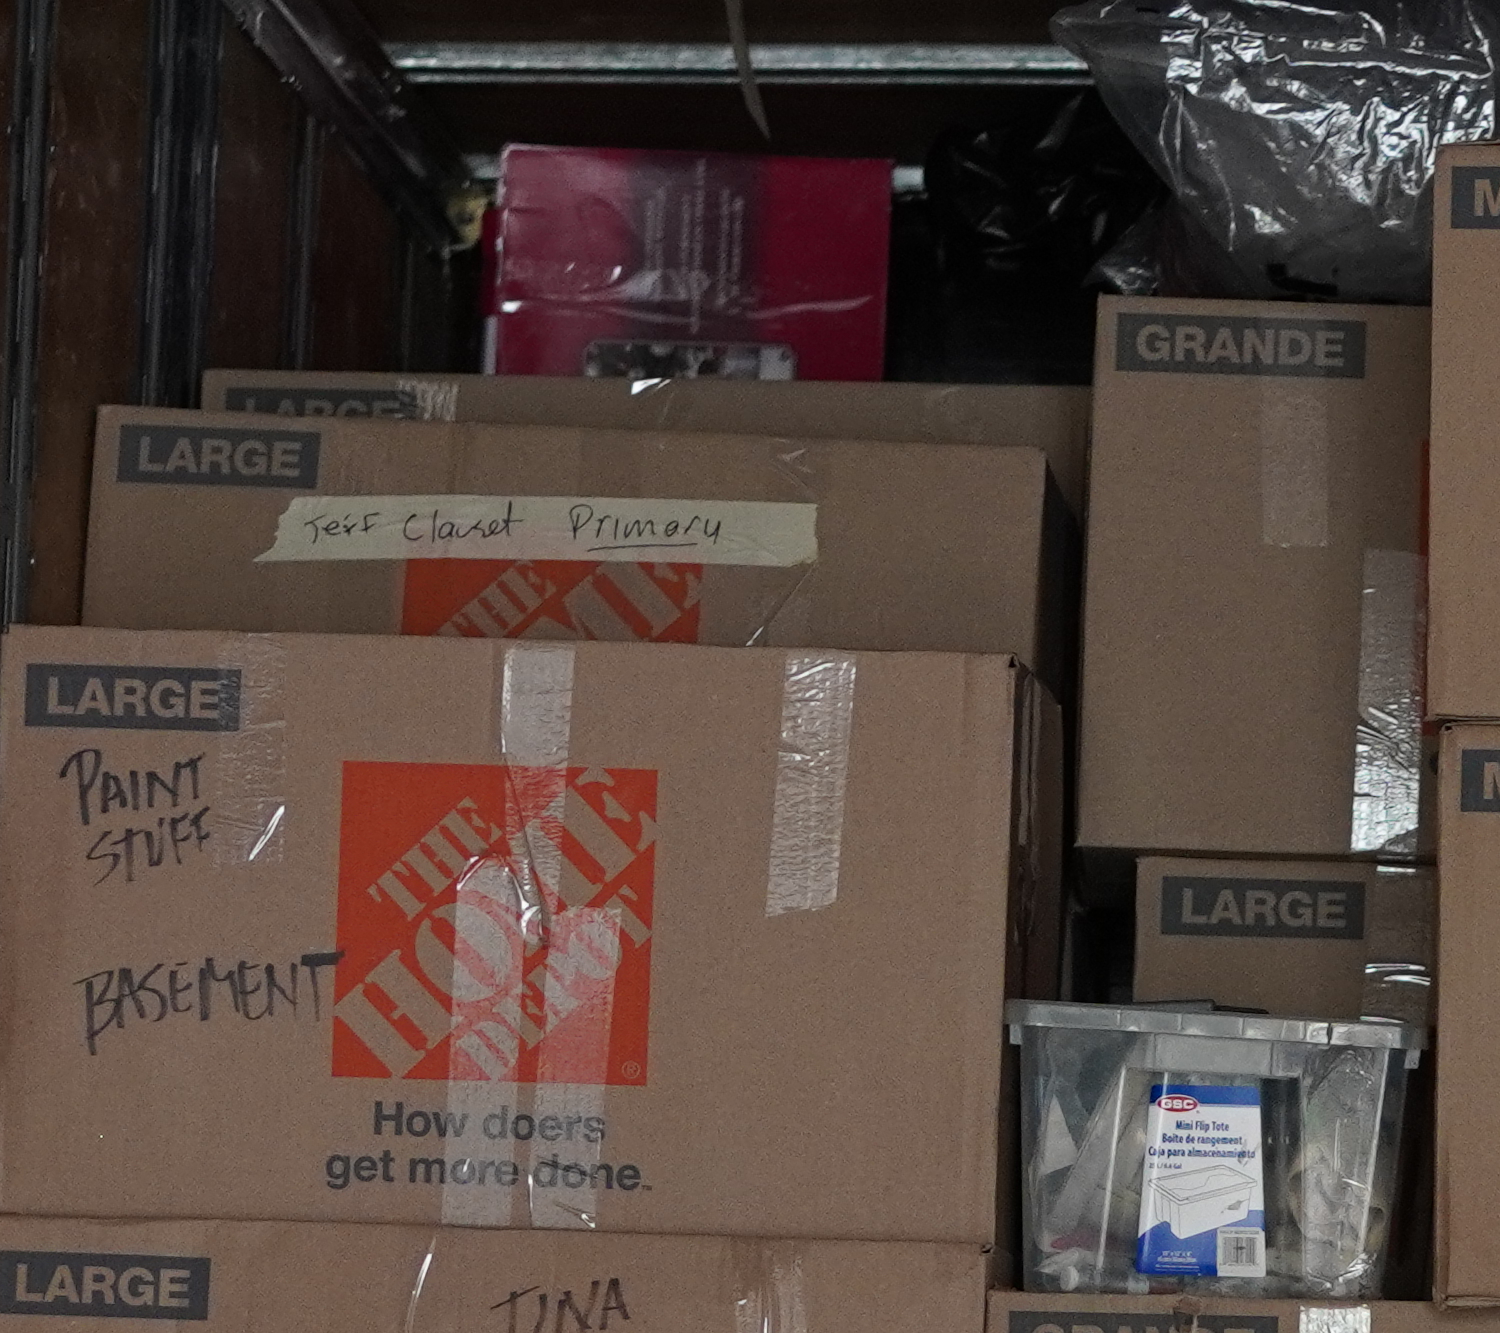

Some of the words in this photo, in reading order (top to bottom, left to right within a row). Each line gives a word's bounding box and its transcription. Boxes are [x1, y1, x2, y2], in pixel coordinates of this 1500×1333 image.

[1135, 324, 1345, 369] GRANDE
[138, 435, 301, 478] LARGE
[46, 676, 221, 719] LARGE
[59, 748, 206, 825] PAINT
[86, 806, 211, 886] STUFF
[367, 796, 503, 922] THE
[333, 766, 662, 1078] HOME
[1181, 889, 1348, 928] LARGE
[73, 951, 346, 1056] BASEMENT
[373, 1101, 469, 1138] How
[482, 1105, 606, 1142] doers
[1160, 1099, 1195, 1110] GSC
[1175, 1120, 1194, 1131] Mini
[1195, 1120, 1211, 1133] Flip
[1212, 1121, 1230, 1132] Tote
[1186, 1133, 1196, 1144] de
[1197, 1136, 1243, 1147] rangement
[326, 1150, 396, 1190] get
[408, 1157, 520, 1188] more
[1167, 1148, 1186, 1159] para
[12, 1263, 192, 1309] LARGE
